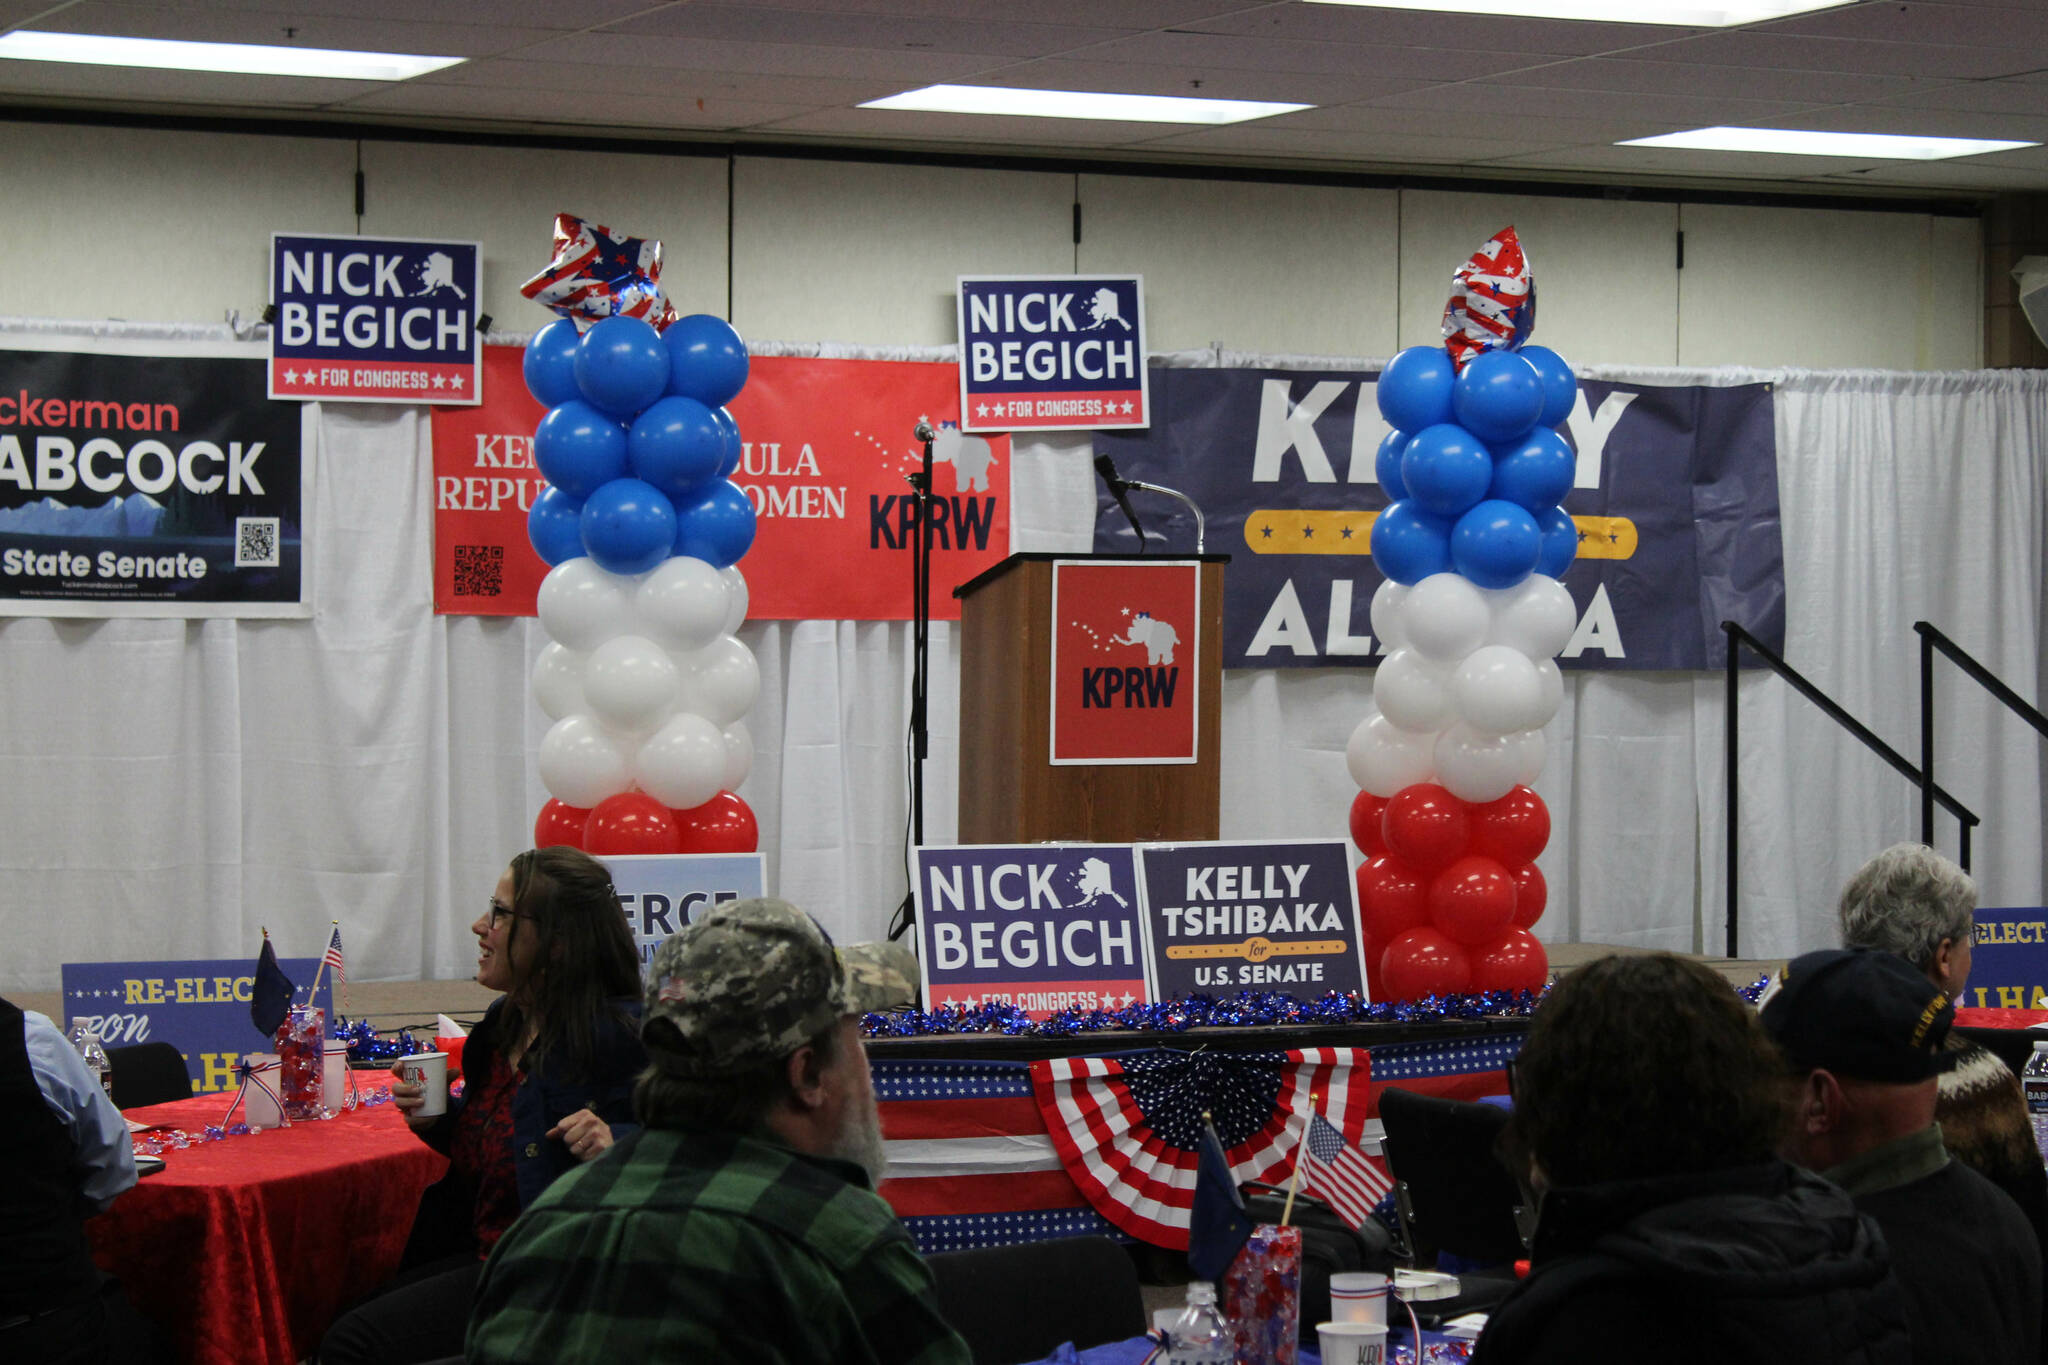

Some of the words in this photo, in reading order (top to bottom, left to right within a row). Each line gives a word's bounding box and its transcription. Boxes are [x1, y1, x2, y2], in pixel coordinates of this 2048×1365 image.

[283, 250, 404, 298] NICK
[282, 302, 467, 351] BEGICH
[970, 293, 1077, 333] NICK
[320, 368, 349, 387] FOR
[353, 369, 429, 389] CONGRESS
[972, 340, 1134, 382] BEGICH
[1008, 401, 1033, 418] FOR
[1036, 399, 1103, 417] CONGRESS
[870, 494, 997, 551] KPRW
[3, 548, 92, 577] State
[97, 551, 208, 579] Senate
[1082, 667, 1179, 709] KPRW
[929, 863, 1064, 912] NICK
[1186, 864, 1311, 901] KELLY
[1161, 903, 1345, 937] TSHIBAKA
[933, 920, 1134, 971] BEGICH
[1249, 940, 1268, 958] for
[124, 977, 256, 1004] RE-ELEC
[1195, 966, 1234, 986] U.S.
[1238, 963, 1324, 985] SENATE
[1016, 991, 1098, 1012] CONGRESS
